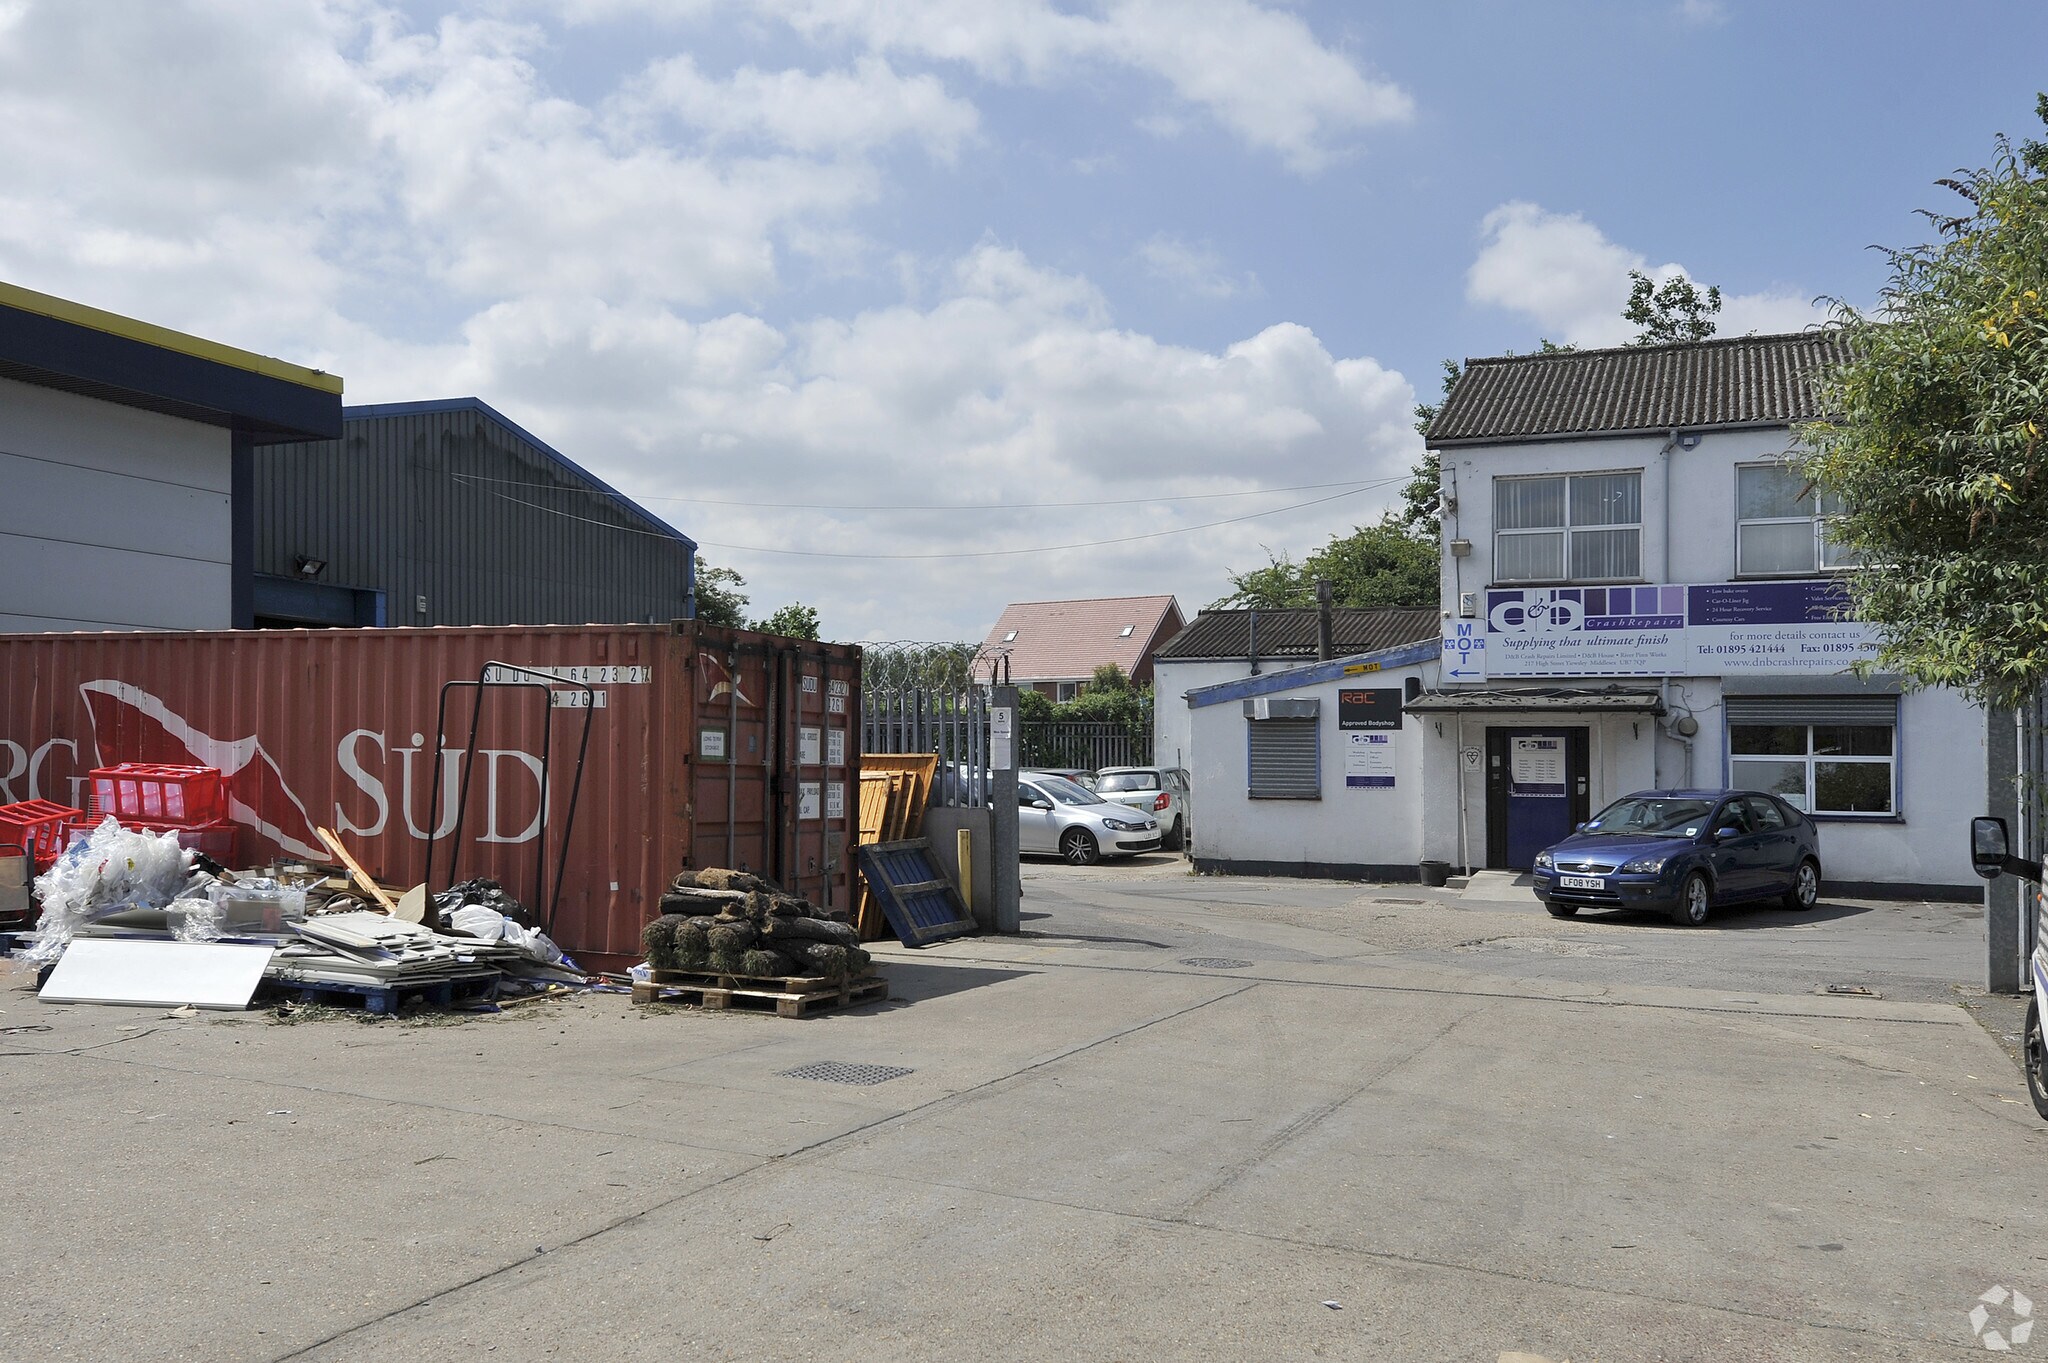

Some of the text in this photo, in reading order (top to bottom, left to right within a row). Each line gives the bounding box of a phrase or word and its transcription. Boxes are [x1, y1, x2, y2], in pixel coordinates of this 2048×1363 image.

[1730, 631, 1744, 640] for
[1774, 631, 1806, 640] details
[1809, 631, 1846, 639] contact
[1502, 634, 1669, 650] Supplying that ultimate finish
[1697, 645, 1714, 654] Tel:
[1716, 645, 1747, 654] 01895
[1749, 644, 1786, 653] 421444
[1801, 644, 1820, 653] Fax:
[1823, 643, 1854, 652] 01895
[335, 728, 550, 844] SÜD
[1564, 878, 1601, 888] LF08 YSH
